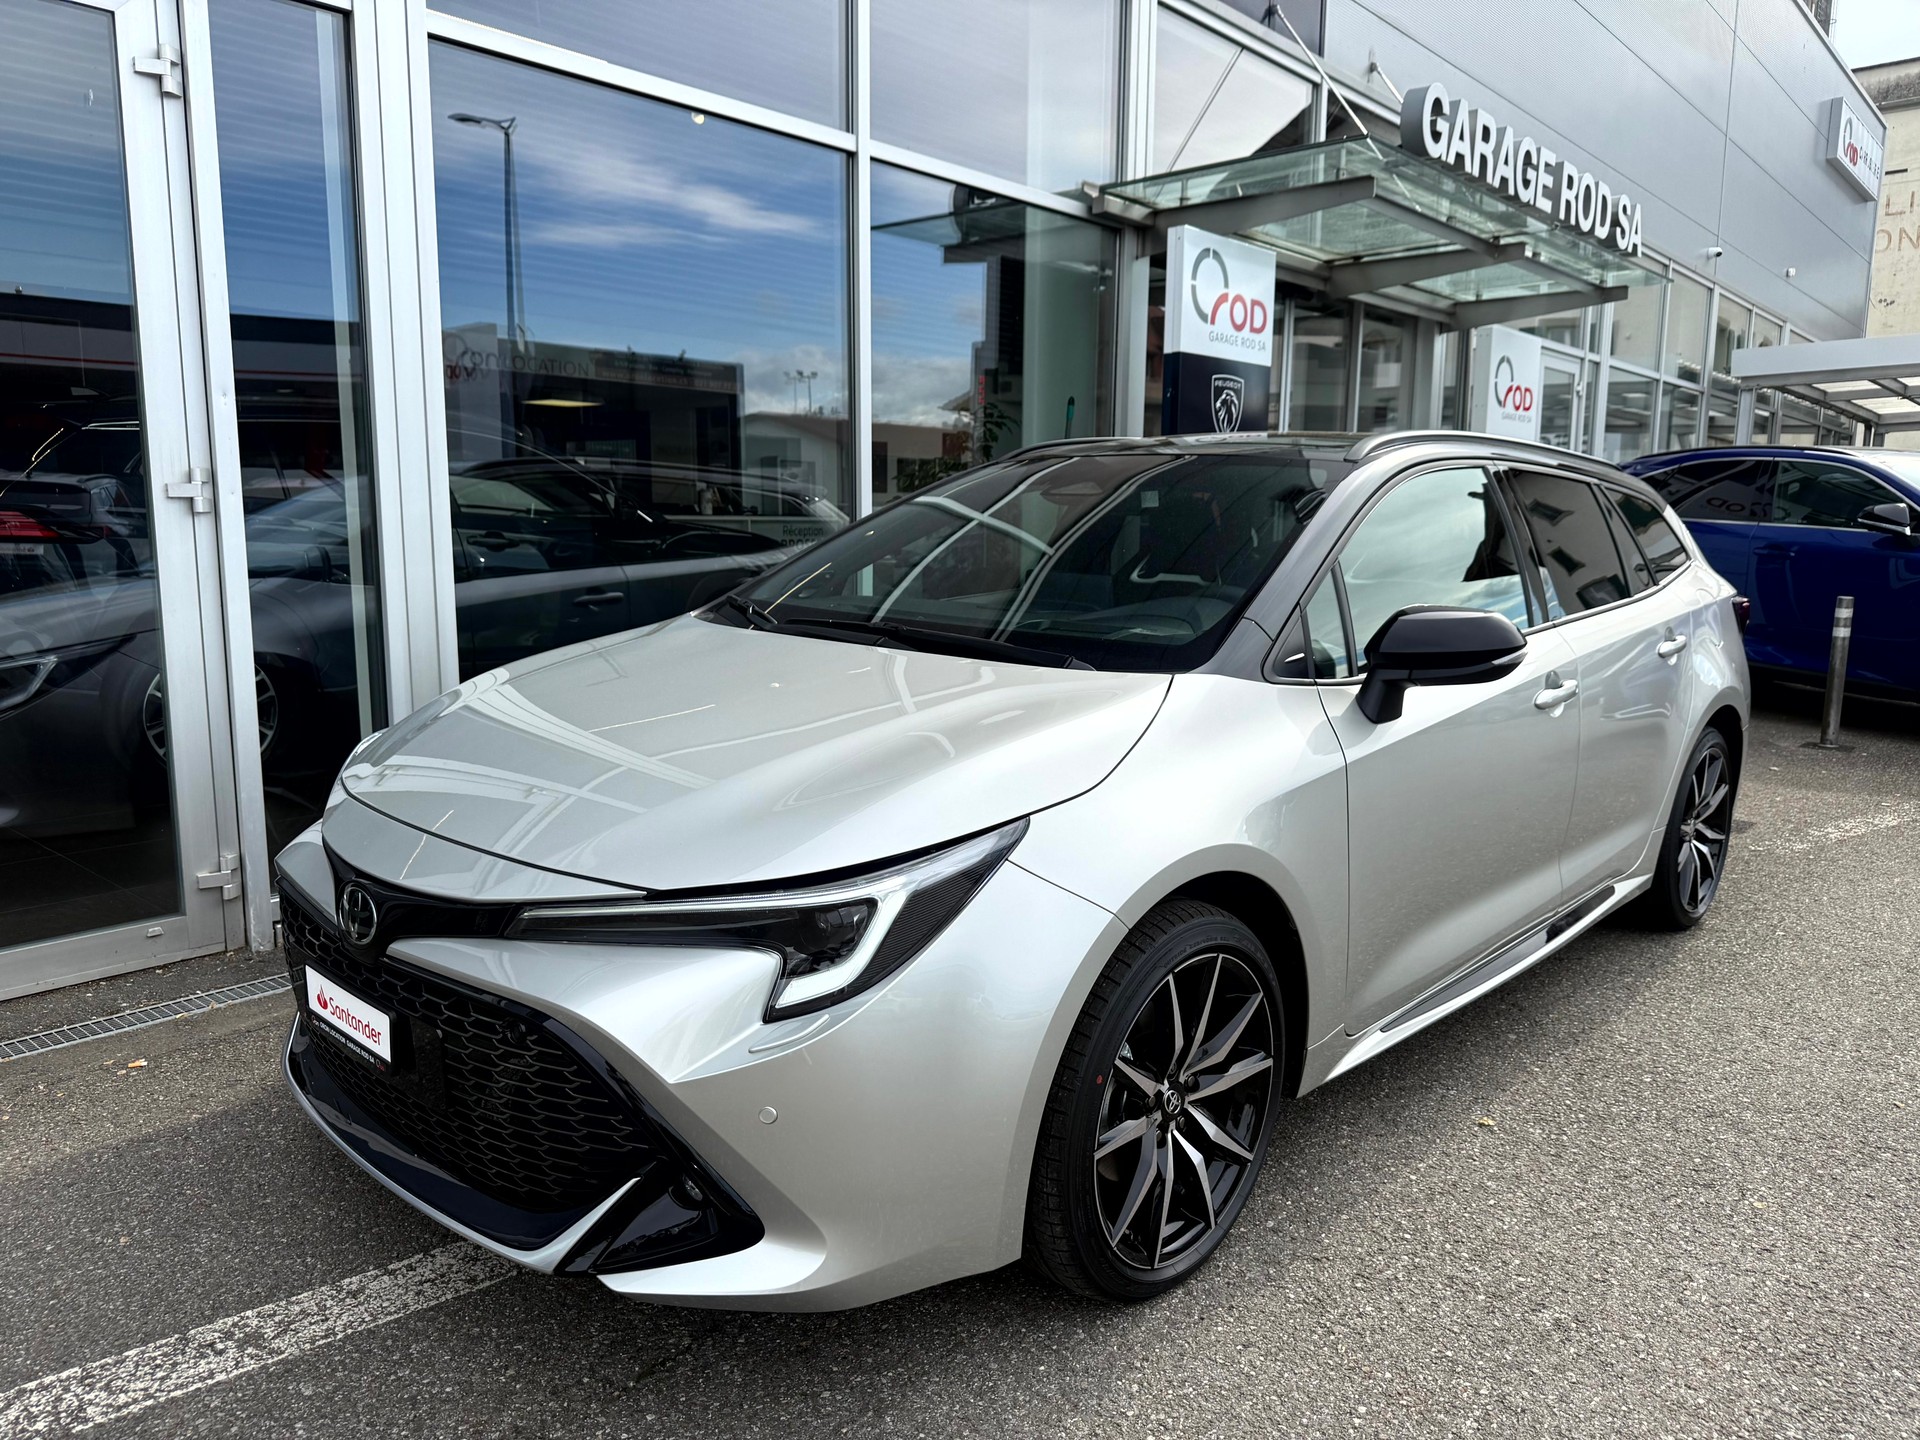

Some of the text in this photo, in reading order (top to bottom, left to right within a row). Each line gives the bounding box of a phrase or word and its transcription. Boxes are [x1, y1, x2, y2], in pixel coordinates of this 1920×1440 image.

[1422, 82, 1642, 258] GARAGE ROD SA
[1208, 331, 1266, 351] GARAGE ROD SA
[1214, 379, 1241, 389] PEUGEOT
[328, 996, 382, 1046] Santander
